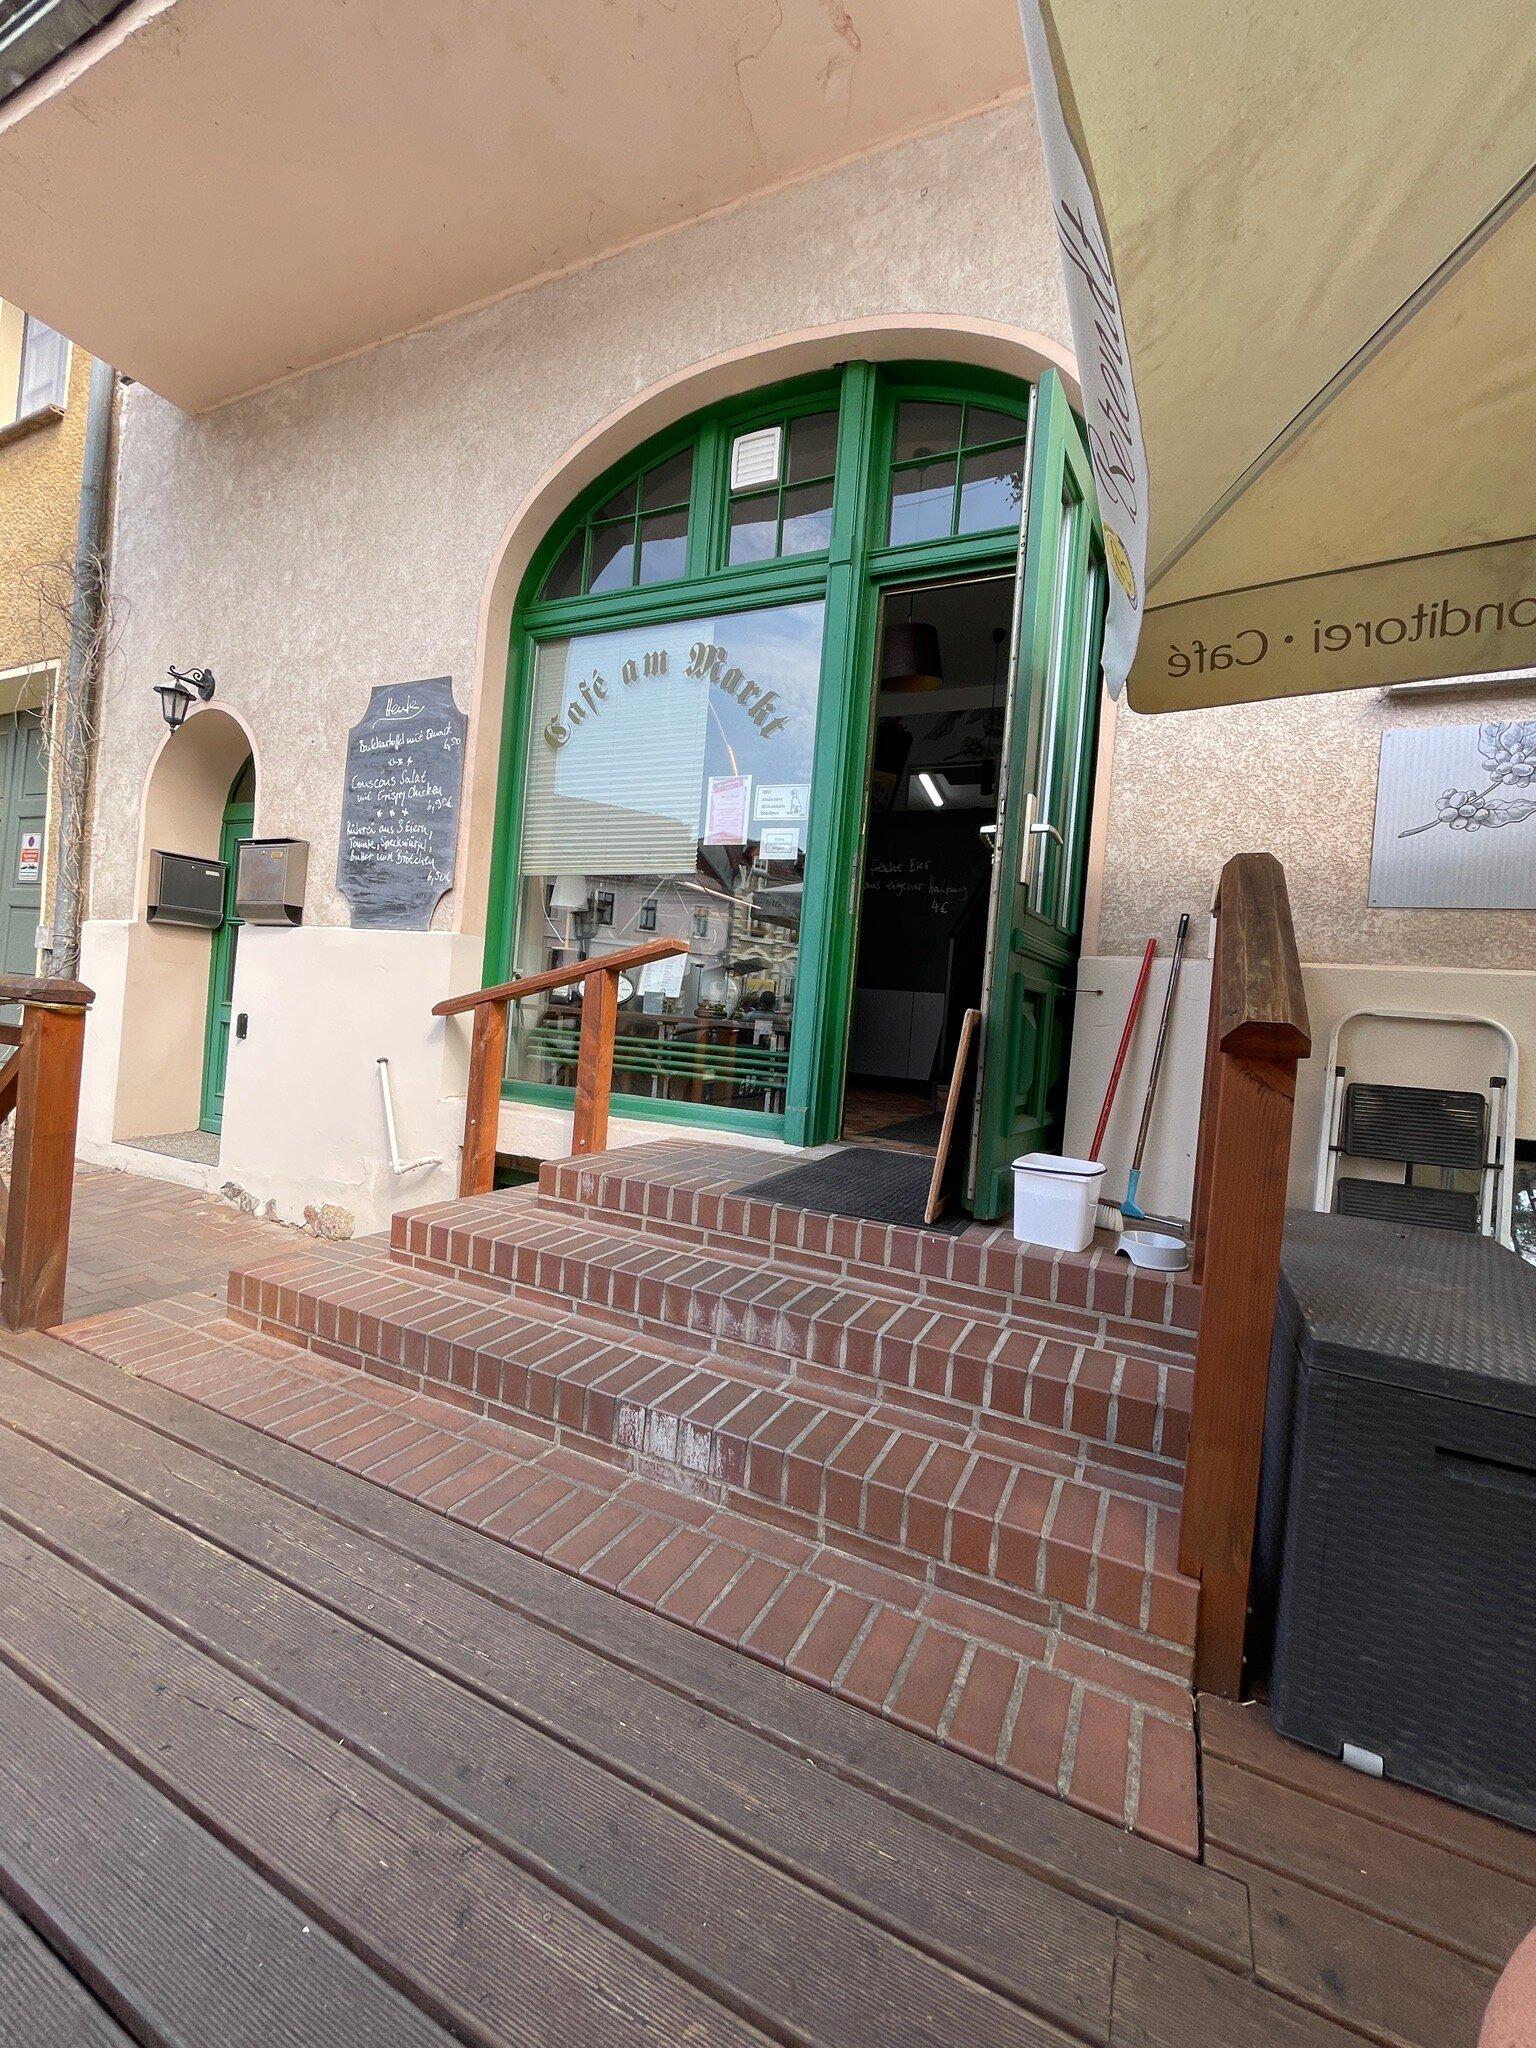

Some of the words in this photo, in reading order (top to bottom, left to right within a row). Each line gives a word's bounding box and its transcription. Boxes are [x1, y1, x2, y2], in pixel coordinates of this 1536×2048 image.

[385, 695, 420, 717] Heute
[543, 668, 608, 749] Café
[621, 649, 671, 688] am
[683, 641, 790, 740] Markt
[406, 730, 423, 745] mit
[425, 721, 453, 741] Quark
[351, 774, 396, 789] Couscous
[400, 769, 427, 785] Salat
[357, 791, 372, 803] mit
[377, 789, 405, 807] Crispy
[407, 782, 443, 799] Chicken
[346, 821, 376, 836] Rührei
[379, 825, 395, 835] aus
[396, 819, 405, 834] 3
[376, 851, 394, 862] und
